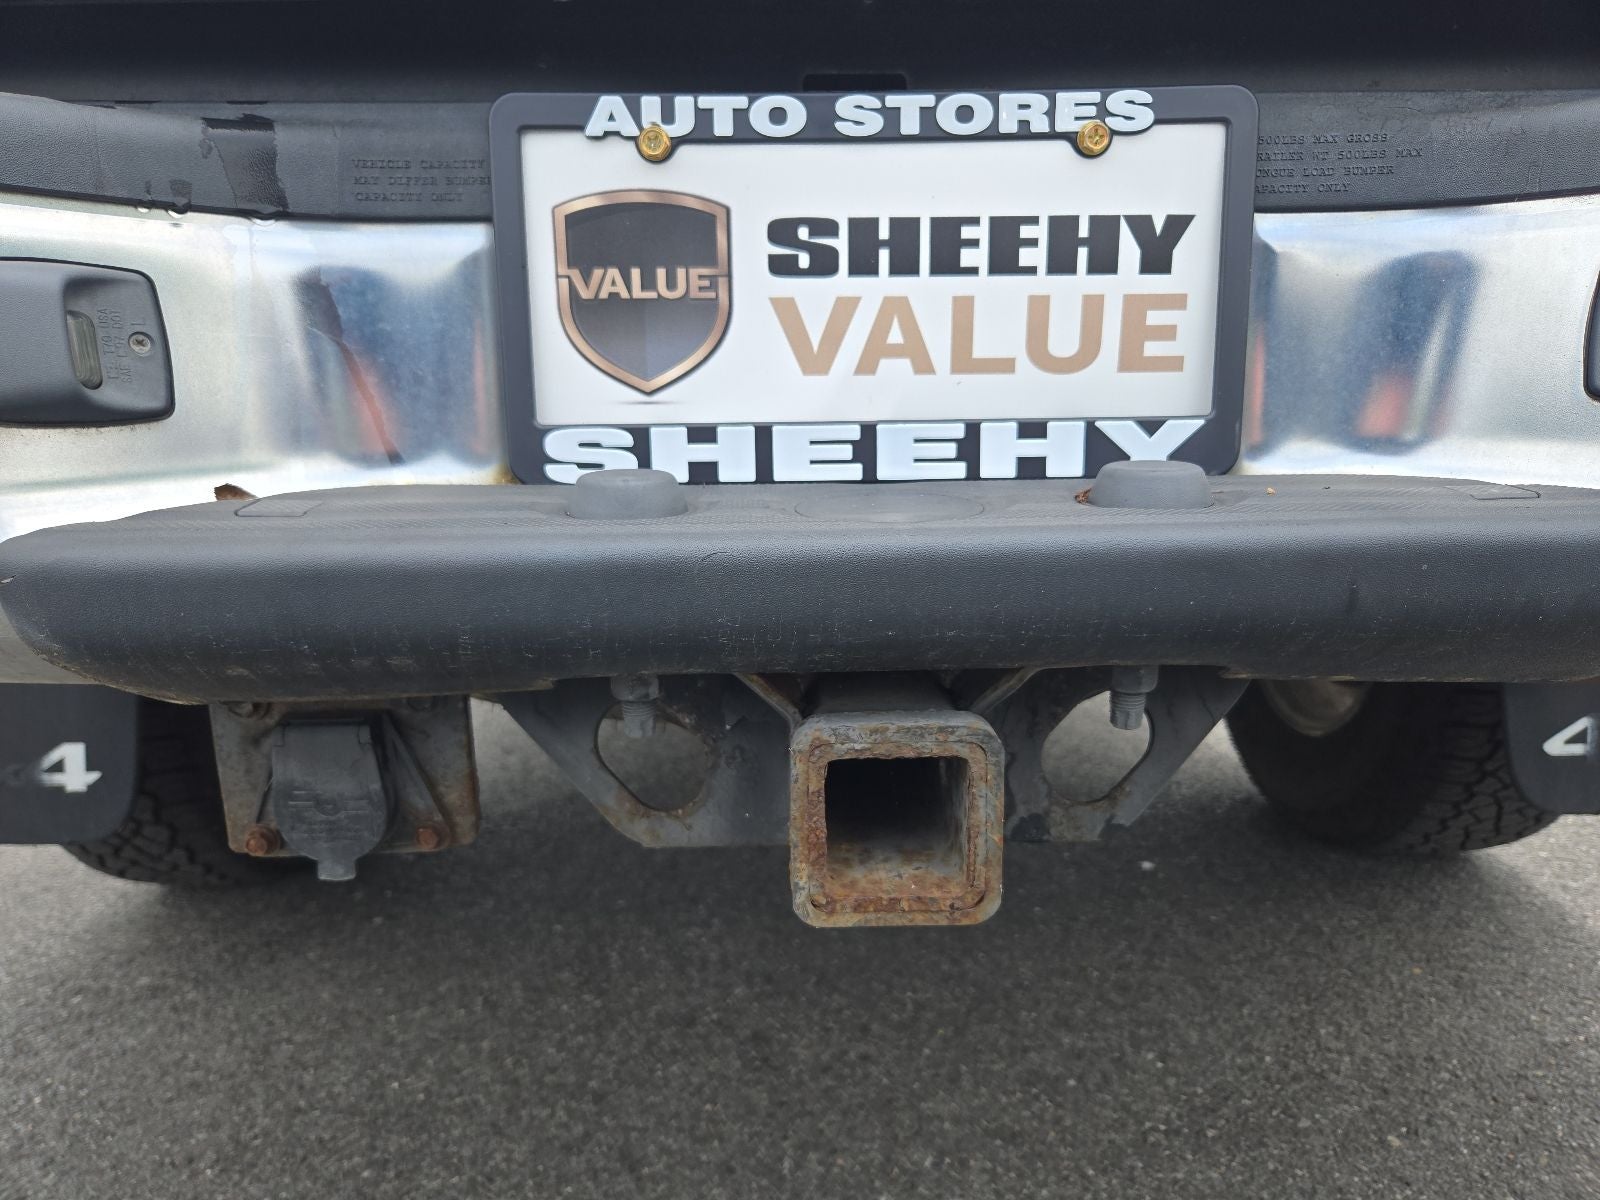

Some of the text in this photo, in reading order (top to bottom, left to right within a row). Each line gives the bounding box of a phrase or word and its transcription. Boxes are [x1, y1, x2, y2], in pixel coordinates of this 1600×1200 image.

[584, 89, 1155, 138] AUTO STORES
[1312, 134, 1340, 144] MAX
[1346, 132, 1389, 143] GROSS
[1256, 151, 1304, 162] RAILER
[1395, 147, 1423, 158] MAX
[351, 159, 486, 170] VEHICLE CAPACITY
[1255, 165, 1395, 178] ONGUE LOAD BUMPER
[387, 175, 439, 186] DIFFER
[1255, 182, 1350, 194] APACITY ONLY
[355, 192, 422, 202] CAPACITY
[767, 214, 1196, 278] SHEEHY
[567, 266, 718, 300] VALUE
[97, 308, 110, 329] USA
[768, 293, 1189, 377] VALUE
[542, 418, 1206, 485] SHEEHY
[38, 741, 103, 793] 4
